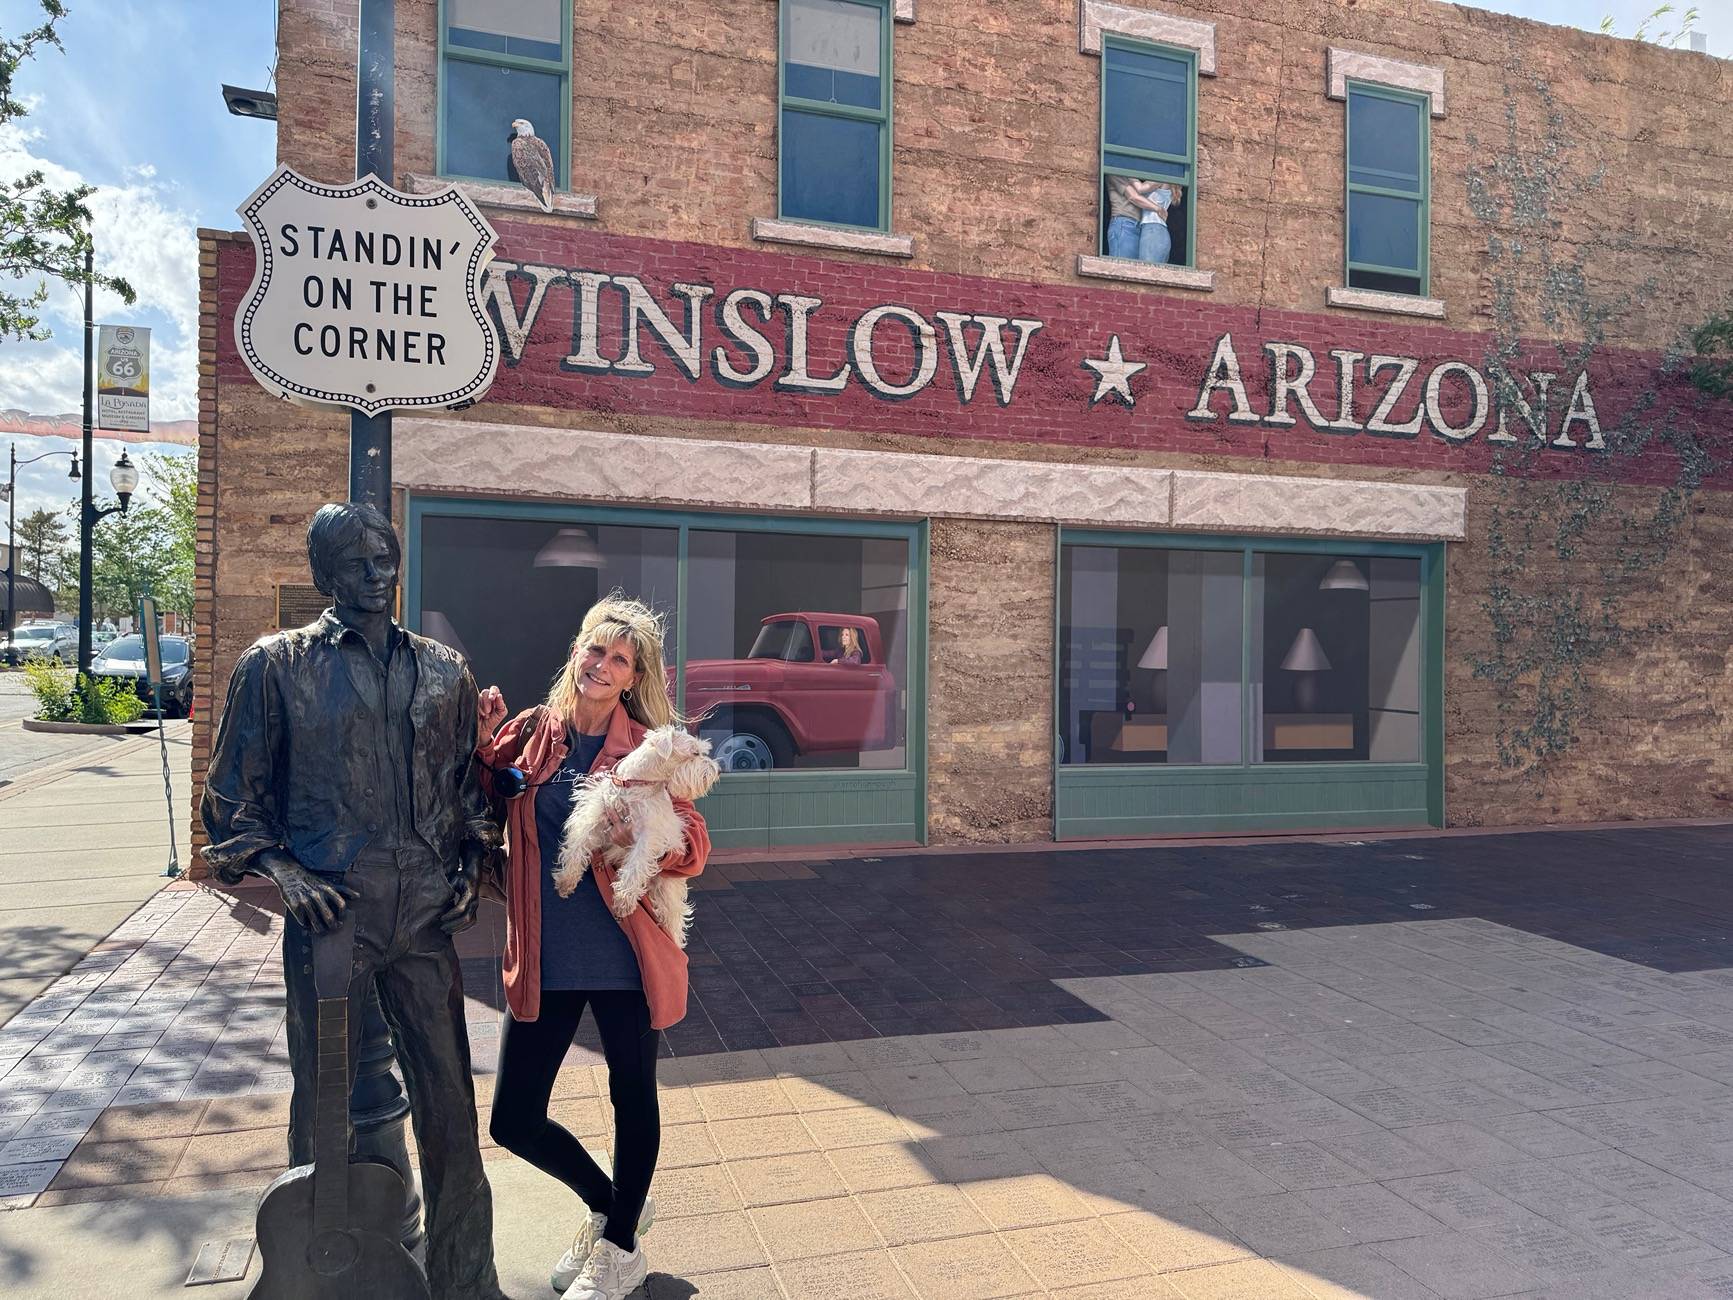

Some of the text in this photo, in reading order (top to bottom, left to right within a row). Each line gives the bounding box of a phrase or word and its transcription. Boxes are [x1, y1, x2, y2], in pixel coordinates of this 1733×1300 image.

[280, 223, 461, 270] STANDIN'
[303, 275, 438, 318] ON THE
[294, 322, 446, 366] CORNER
[481, 260, 1606, 450] WINSLOW ARIZONA
[112, 361, 135, 376] 66
